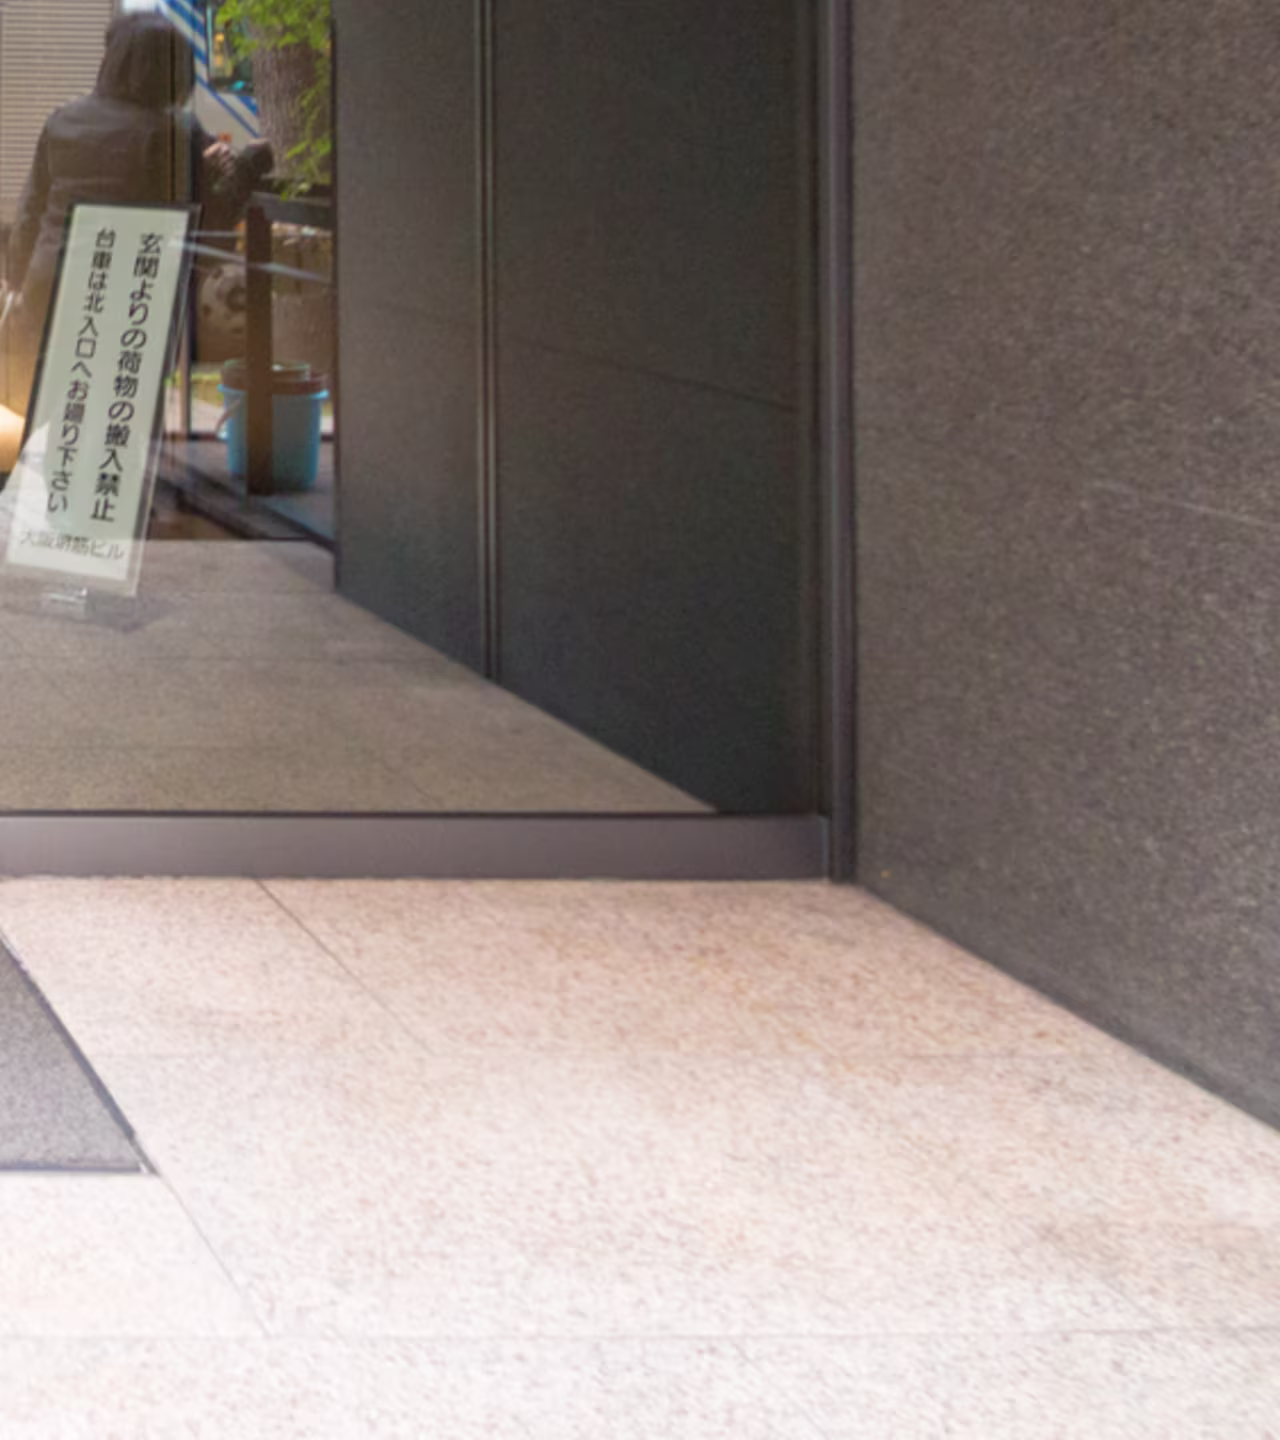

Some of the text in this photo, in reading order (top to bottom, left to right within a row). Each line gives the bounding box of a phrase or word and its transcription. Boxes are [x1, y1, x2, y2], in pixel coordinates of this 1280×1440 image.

[90, 232, 164, 523] 玄関よりの荷物の搬入禁止
